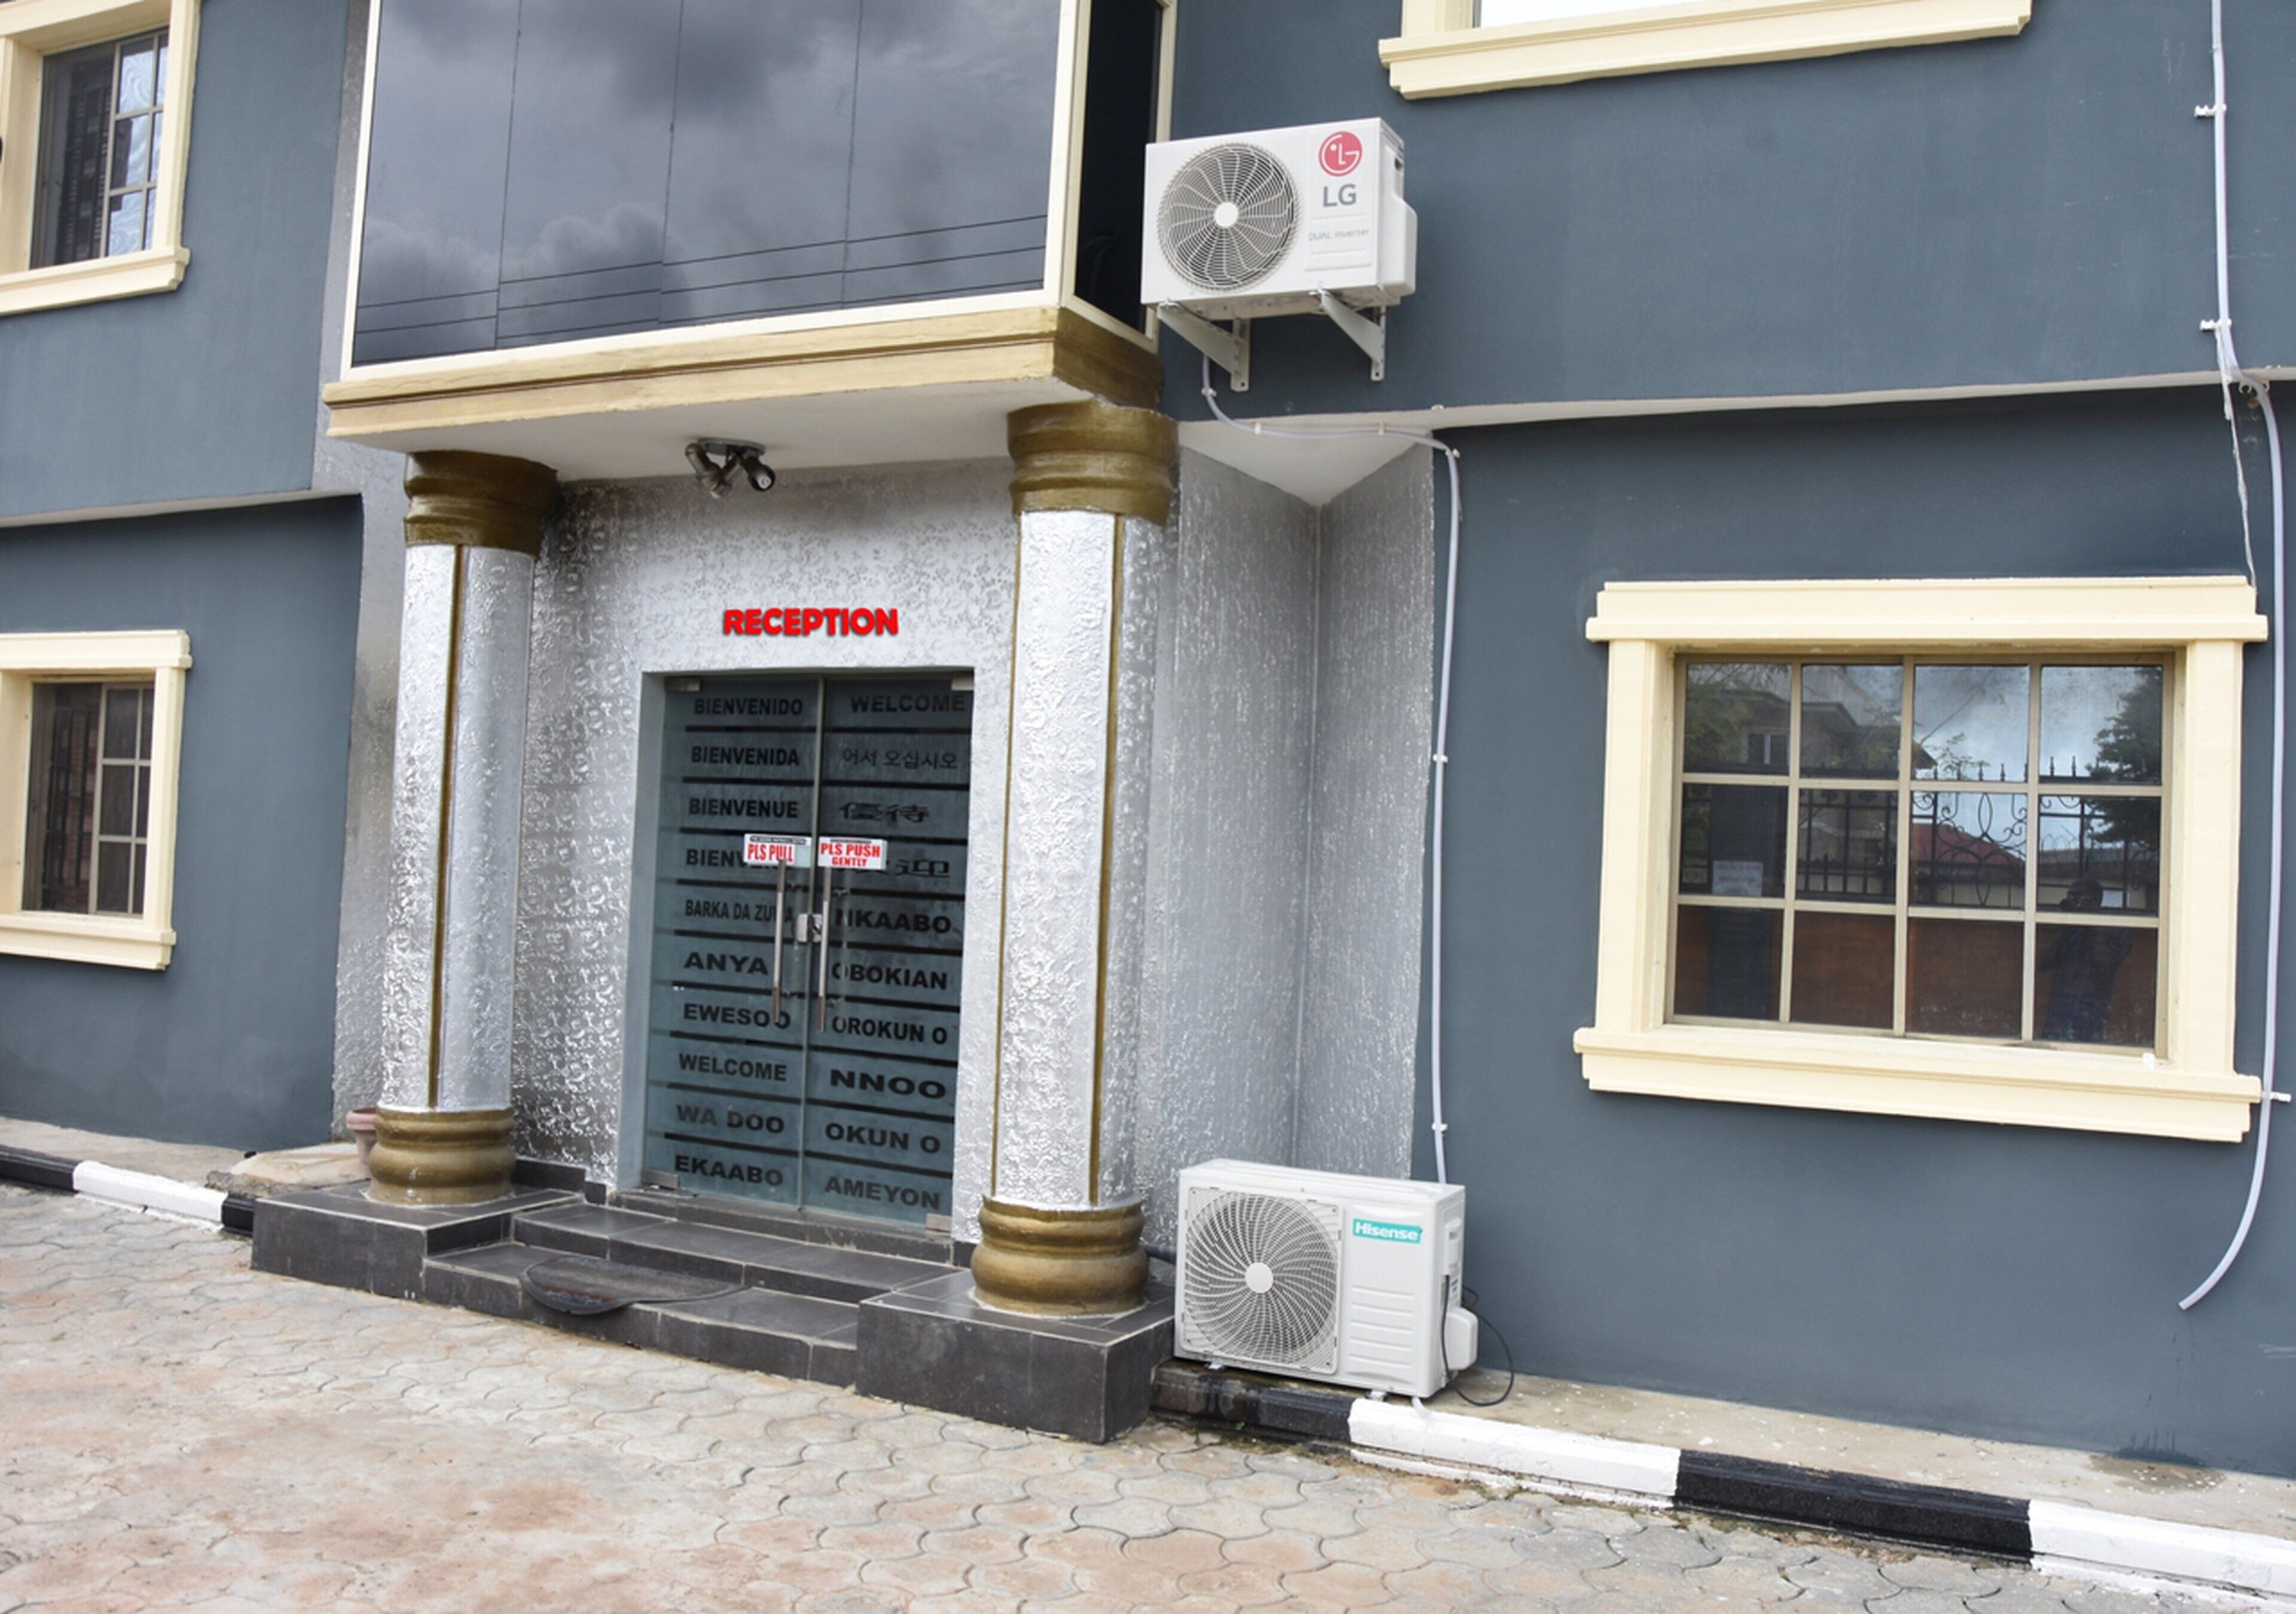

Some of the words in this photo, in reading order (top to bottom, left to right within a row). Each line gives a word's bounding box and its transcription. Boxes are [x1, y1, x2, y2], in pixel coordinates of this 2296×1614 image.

[1323, 184, 1357, 208] LG
[1308, 231, 1331, 241] DUAL
[723, 608, 899, 636] RECEPTION
[694, 698, 803, 715] BIENVENIDO
[850, 694, 965, 712] WELCOME
[691, 746, 800, 766] BIENVENIDA
[842, 749, 877, 767] 어서
[689, 797, 799, 819] BIENVENUE
[748, 844, 767, 861] PLS
[769, 846, 793, 862] PULL
[820, 843, 843, 855] PLS
[846, 844, 881, 858] PUSH
[832, 858, 868, 867] GENTLY
[685, 899, 729, 919] BARKA
[733, 902, 750, 921] DA
[684, 952, 768, 975] ANYA
[832, 963, 947, 990] OBOKIAN
[832, 1016, 924, 1042] OROKUN
[932, 1027, 948, 1044] O
[679, 1053, 787, 1081] WELCOME
[831, 1069, 946, 1099] NNOO
[676, 1105, 718, 1125] WA
[727, 1110, 784, 1134] DOO
[825, 1122, 909, 1150] OKUN
[920, 1136, 941, 1154] O
[675, 1155, 783, 1186] EKAABO
[825, 1176, 940, 1210] AMEYON
[1355, 1222, 1418, 1241] Hisense
